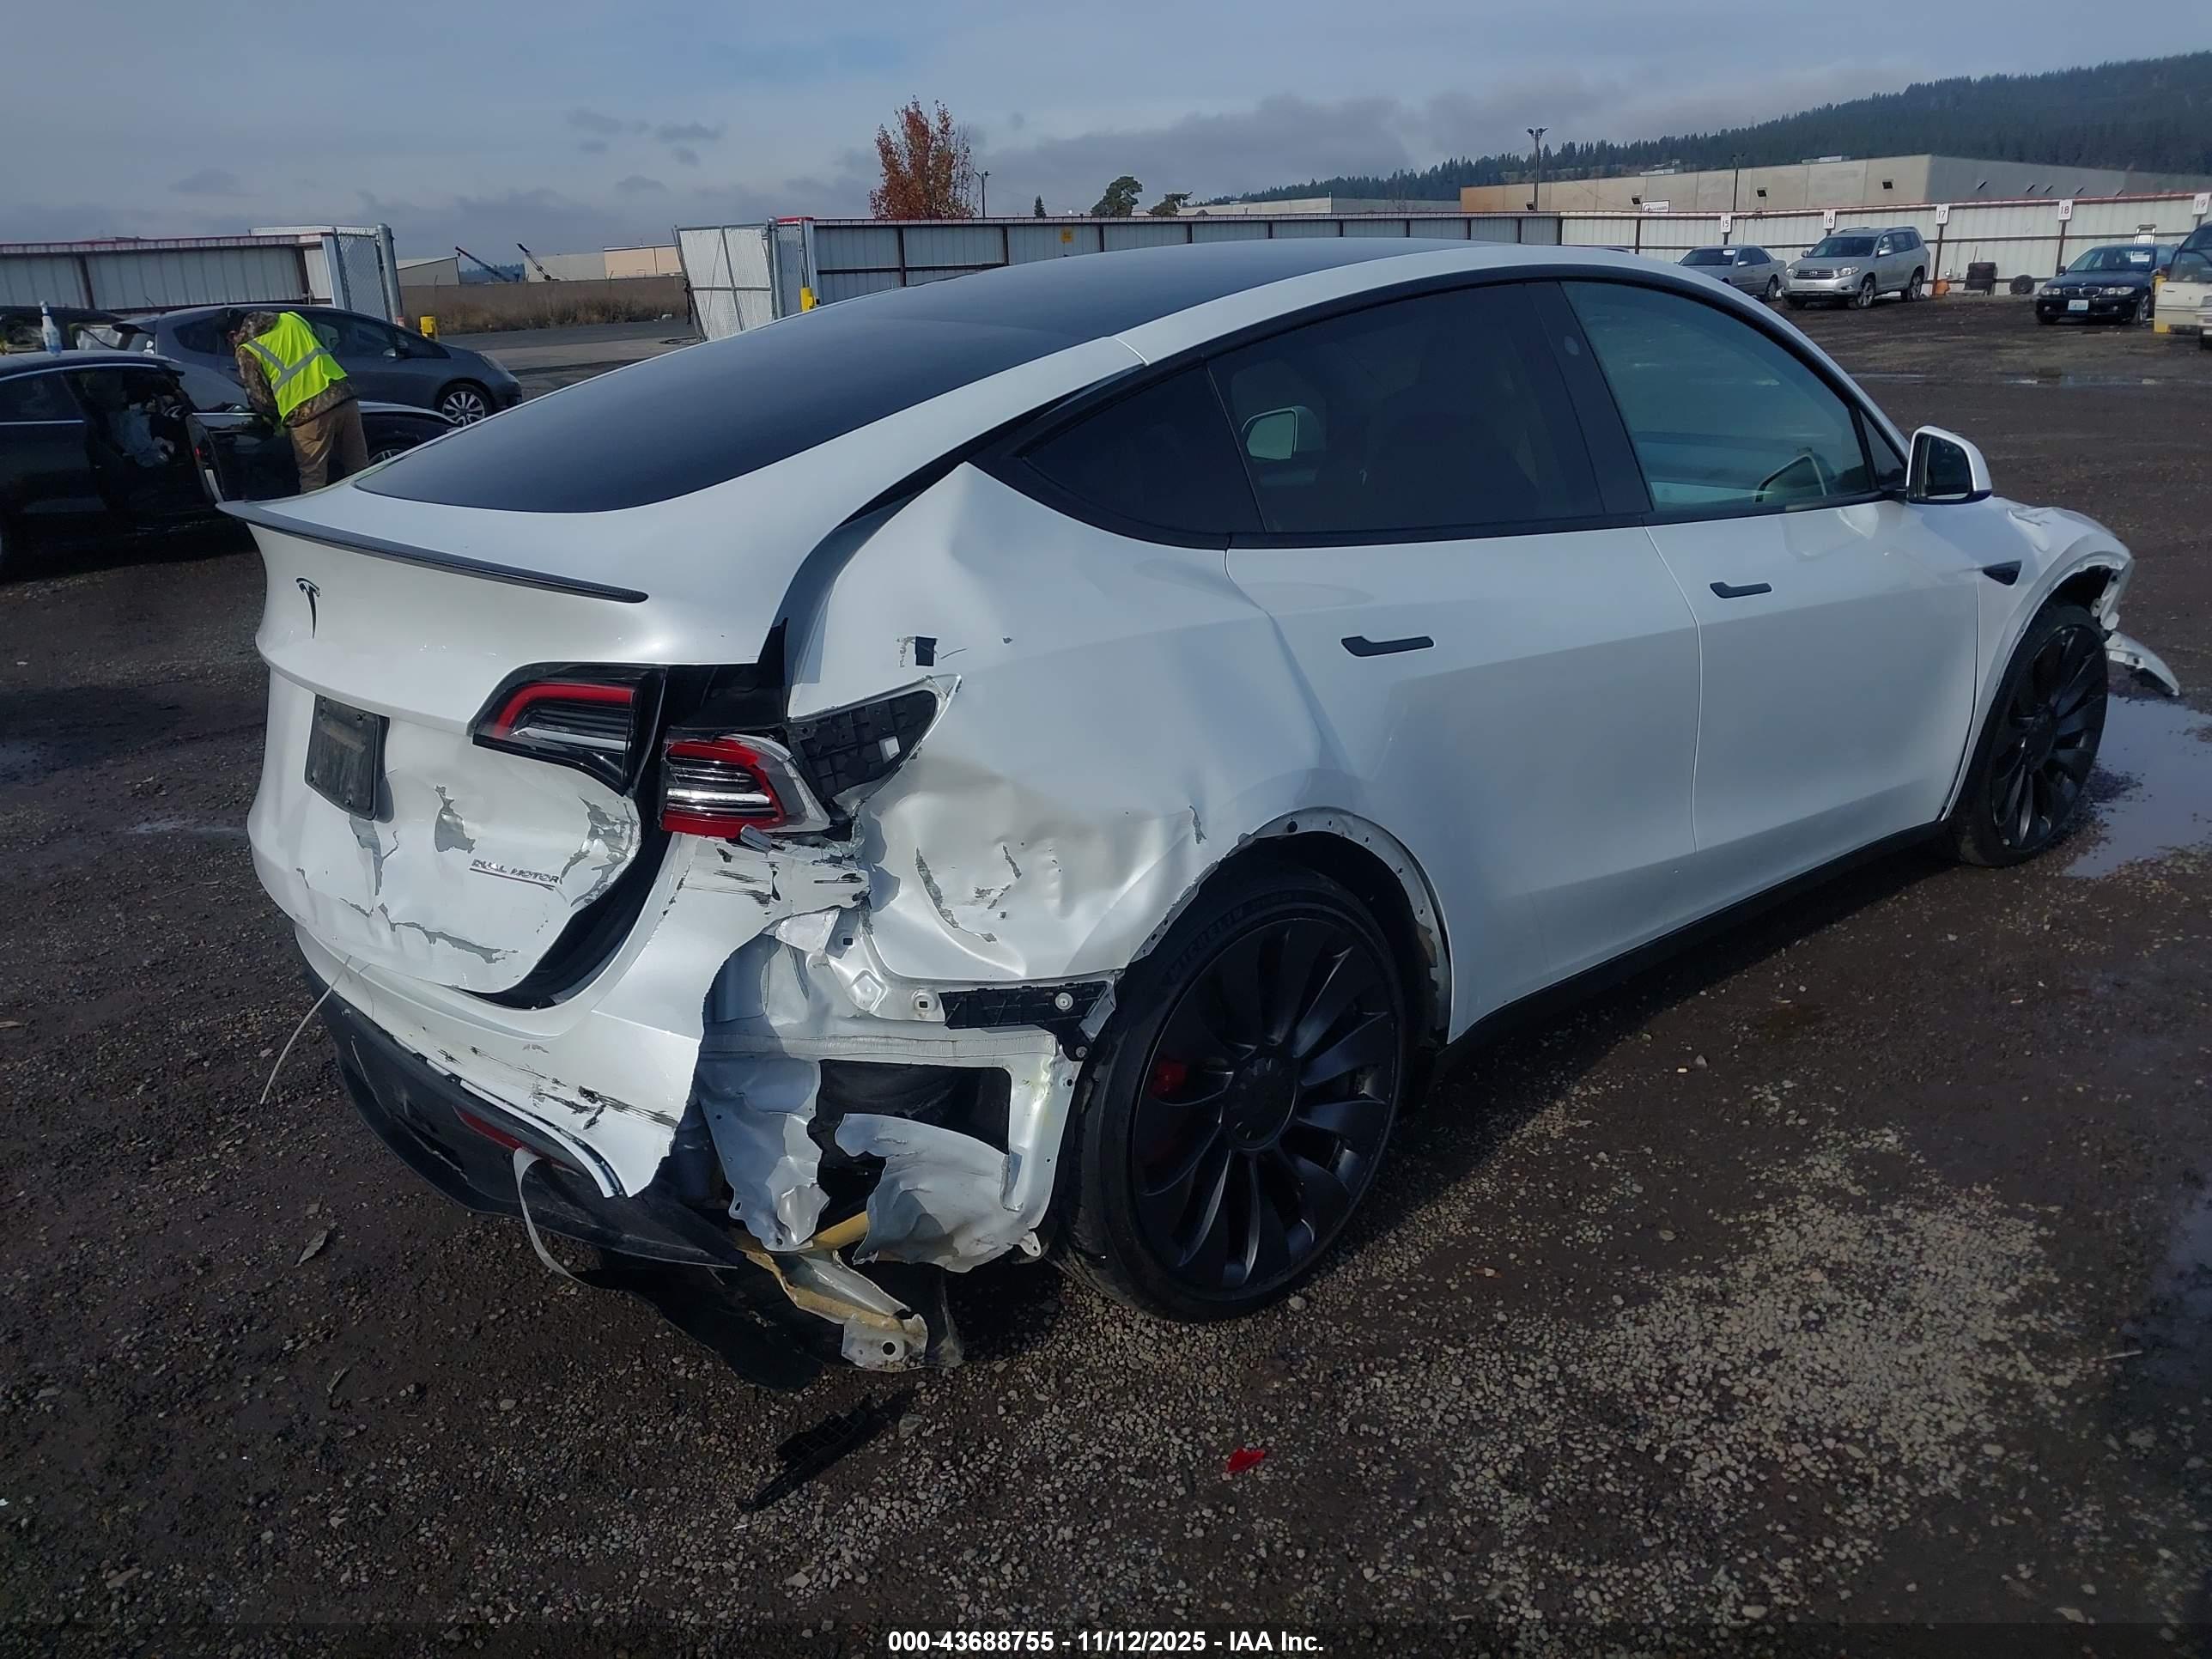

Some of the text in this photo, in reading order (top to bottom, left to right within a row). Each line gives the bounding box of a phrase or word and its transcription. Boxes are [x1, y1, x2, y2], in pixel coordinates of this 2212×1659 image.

[2196, 198, 2207, 209] 19
[1937, 210, 1947, 219] 17
[2060, 205, 2069, 215] 18
[1722, 219, 1729, 228] 15
[1826, 215, 1834, 224] 16
[471, 860, 559, 883] DUAL MOTOR
